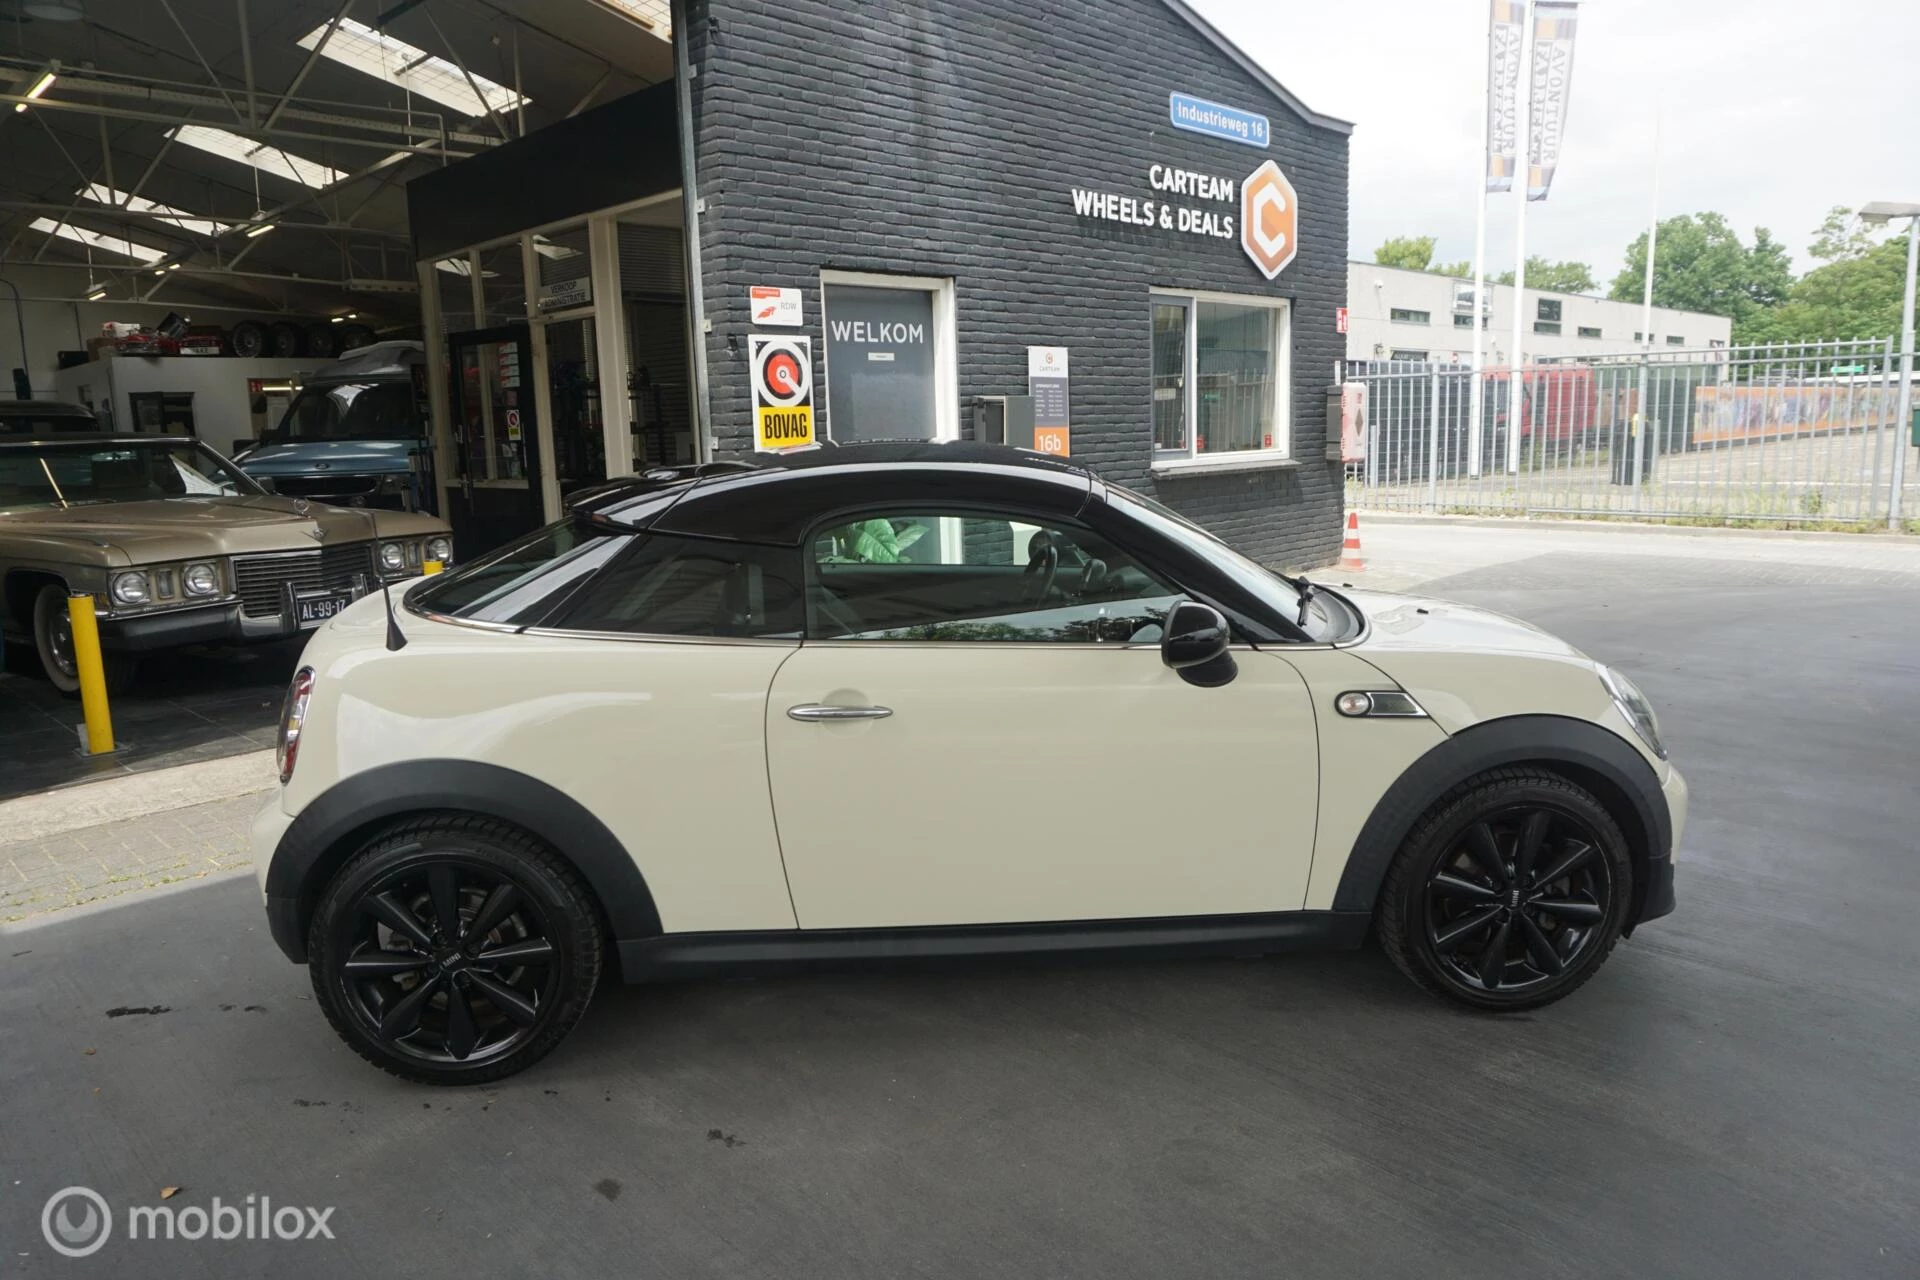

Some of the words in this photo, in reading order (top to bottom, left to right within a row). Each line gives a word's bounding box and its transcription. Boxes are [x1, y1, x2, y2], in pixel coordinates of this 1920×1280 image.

[1543, 46, 1566, 161] AVONTUUR
[1177, 101, 1248, 137] Industrieweg
[1251, 119, 1263, 137] 16
[1149, 164, 1233, 203] CARTEAM
[1072, 189, 1155, 227] WHEELS
[1159, 204, 1173, 230] &
[1178, 207, 1234, 239] DEALS
[780, 302, 797, 311] RDW
[831, 320, 924, 344] WELKOM
[764, 412, 808, 440] BOVAG
[1038, 432, 1062, 452] 16b
[302, 599, 346, 620] AL-99-17
[442, 952, 461, 968] MINI
